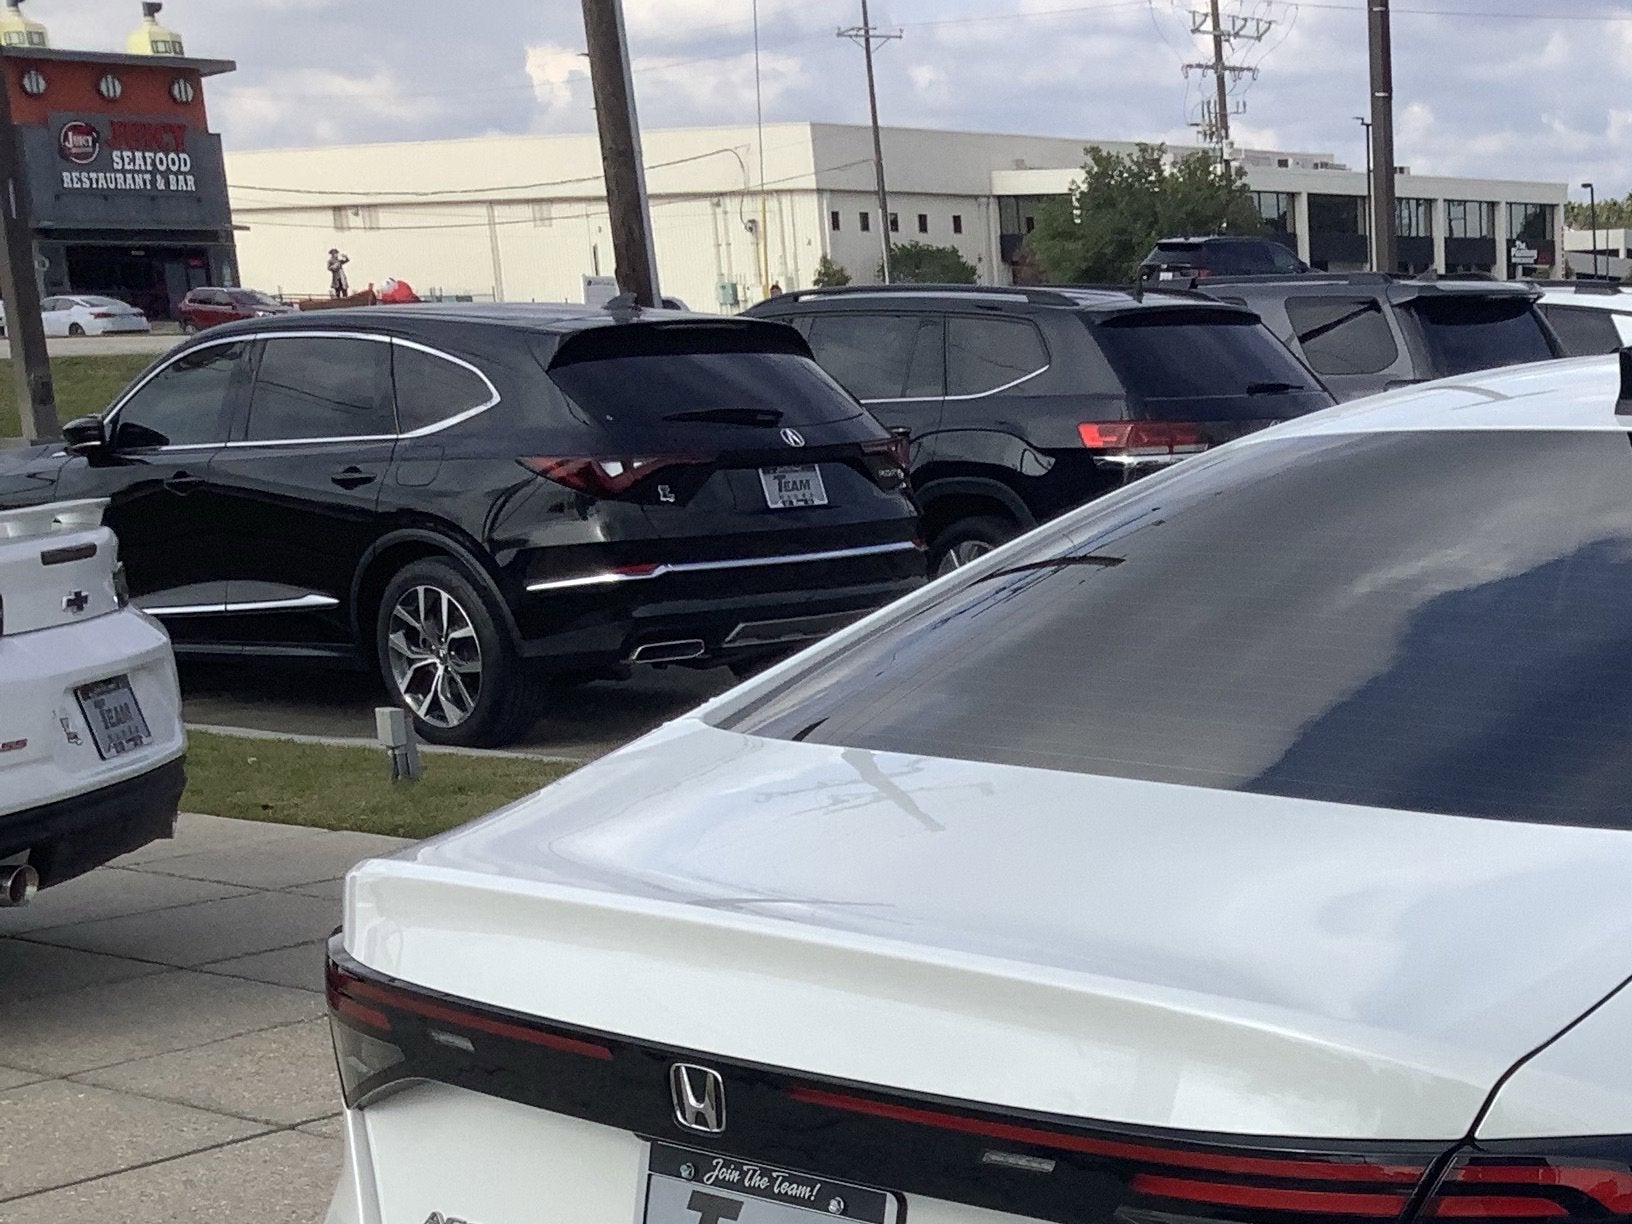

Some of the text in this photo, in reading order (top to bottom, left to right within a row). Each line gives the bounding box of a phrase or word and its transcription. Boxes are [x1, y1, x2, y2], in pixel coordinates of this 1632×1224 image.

[111, 150, 191, 172] SEAFOOD
[62, 171, 196, 192] RESTAURANT & BAR
[703, 1158, 822, 1202] Join The Team!
